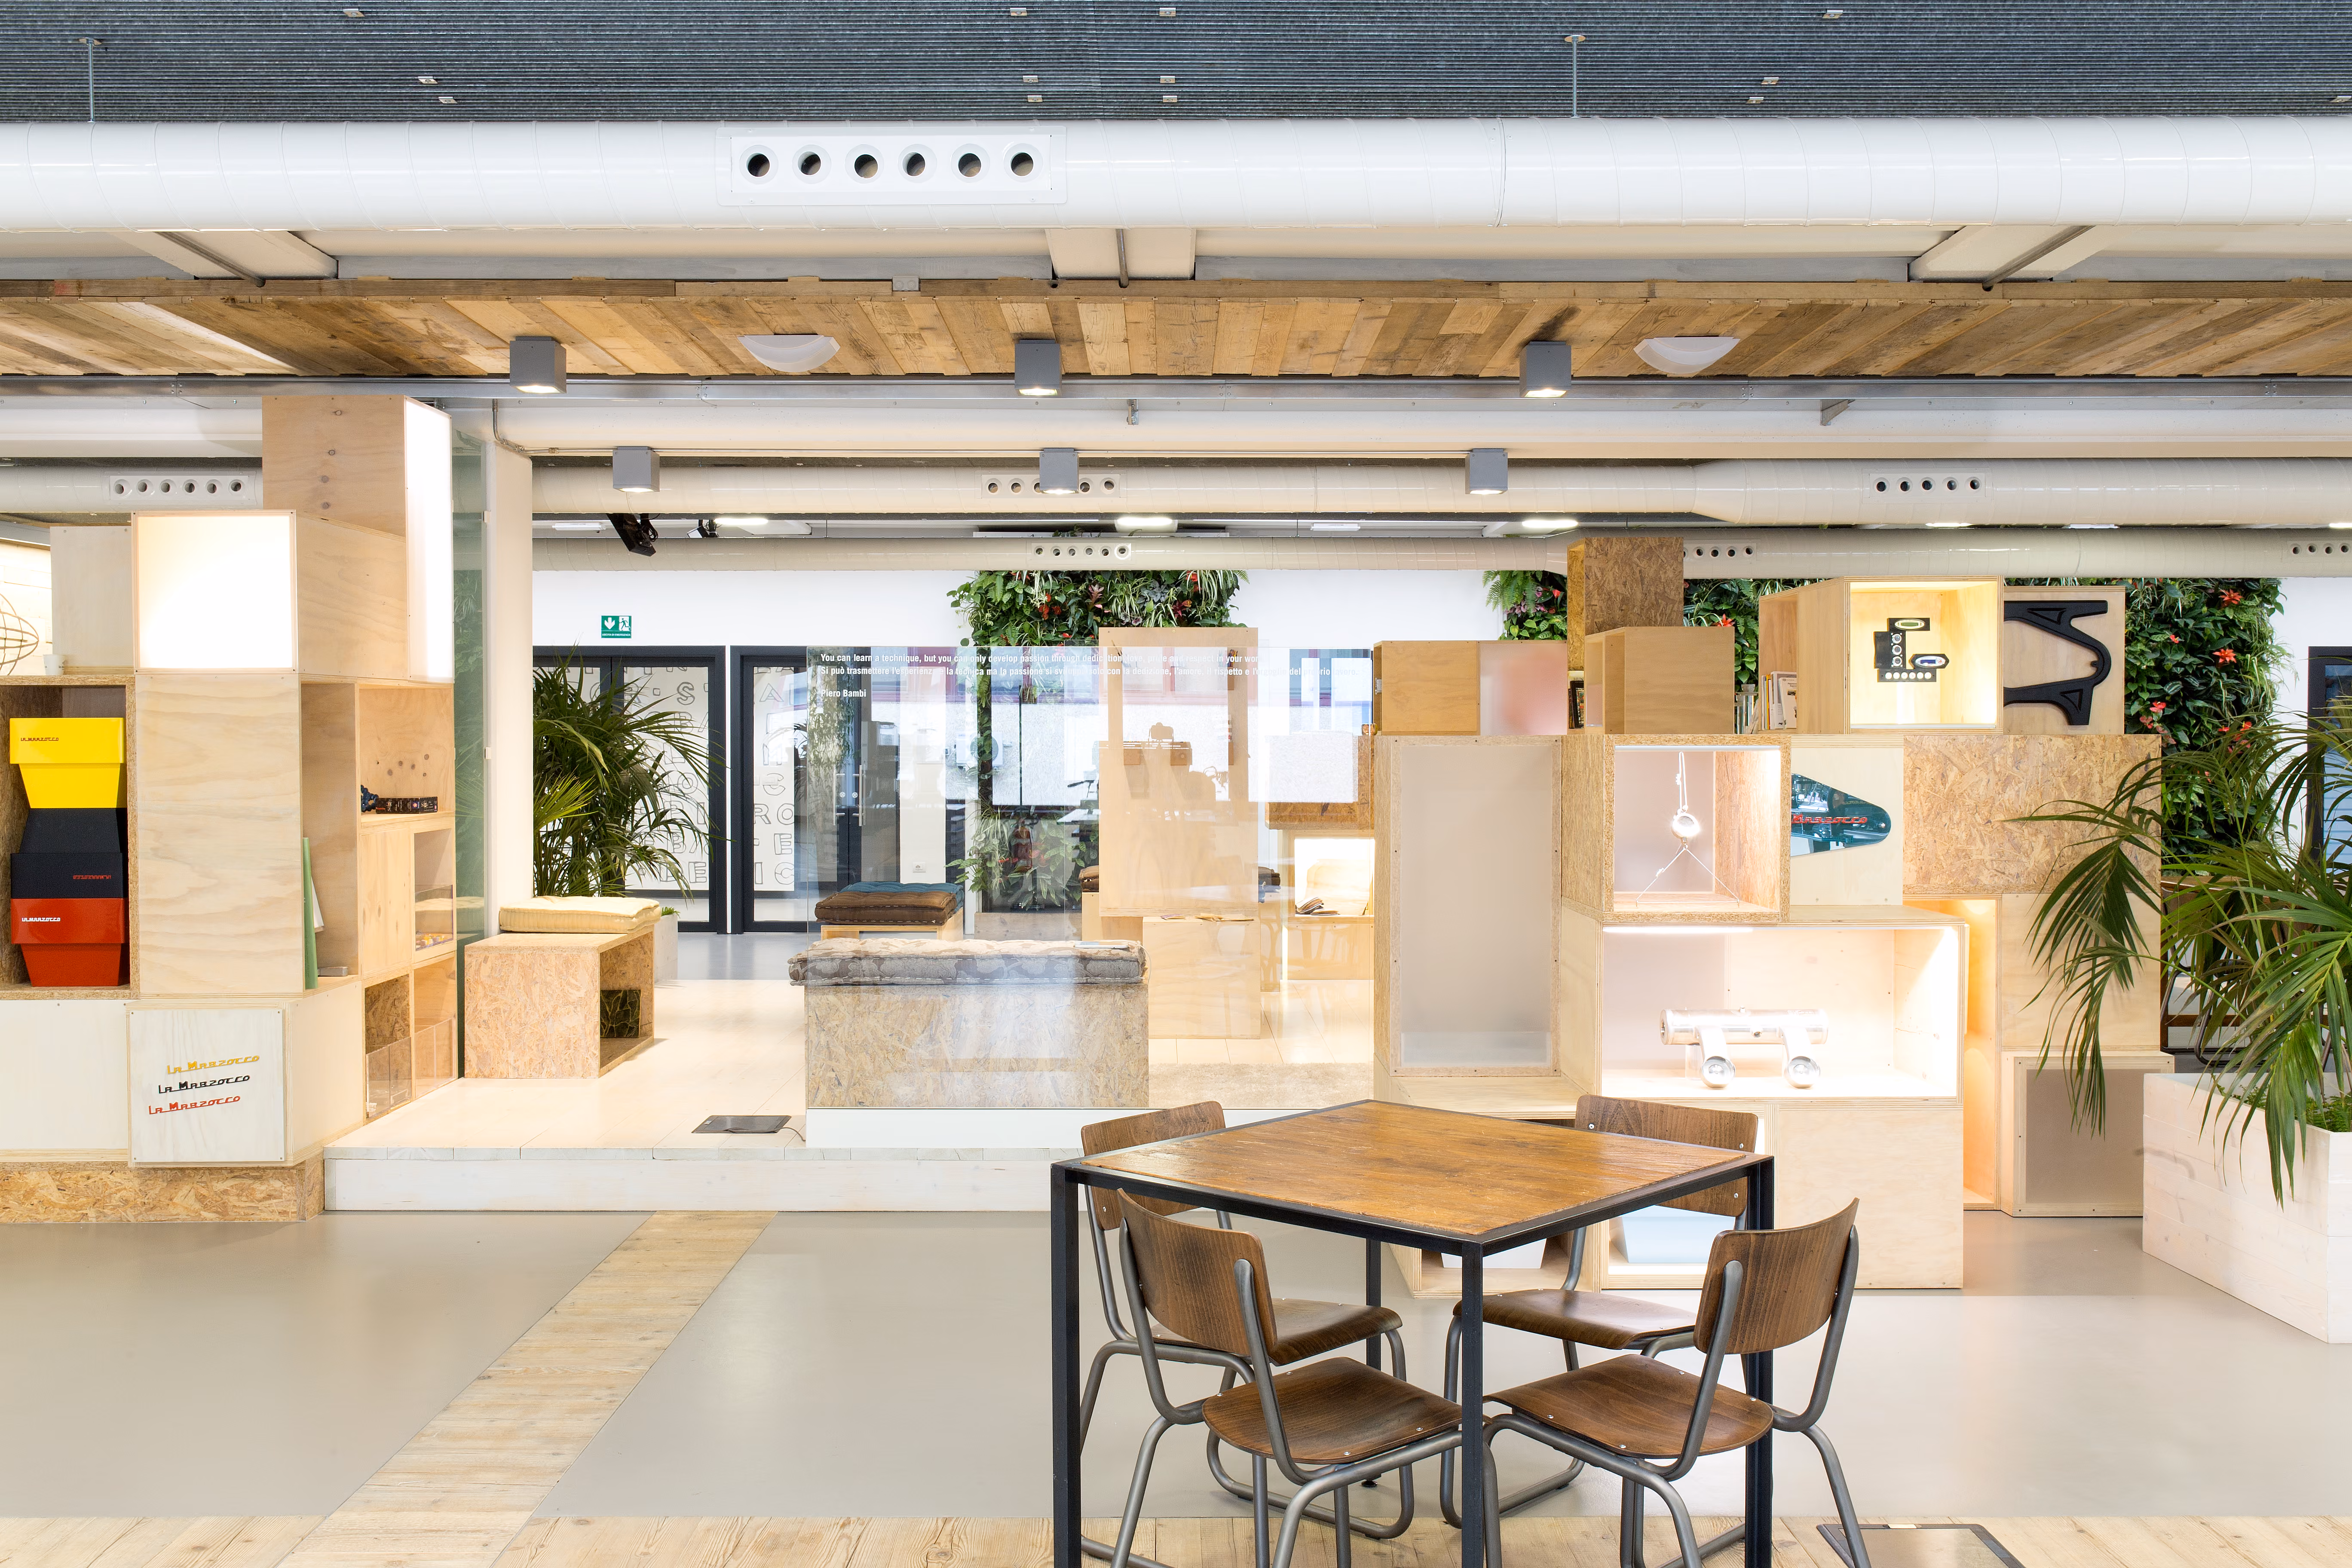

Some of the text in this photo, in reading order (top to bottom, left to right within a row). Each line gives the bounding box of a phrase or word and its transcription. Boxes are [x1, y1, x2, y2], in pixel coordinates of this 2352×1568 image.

[882, 654, 922, 664] technique,
[971, 655, 986, 664] only
[989, 655, 1017, 664] develop
[1020, 655, 1049, 664] passion
[1052, 655, 1080, 664] through
[831, 667, 844, 676] può
[1010, 668, 1043, 677] passione
[1133, 668, 1172, 676] dedizione,
[1215, 668, 1243, 676] rispetto
[843, 689, 866, 697] Bambi
